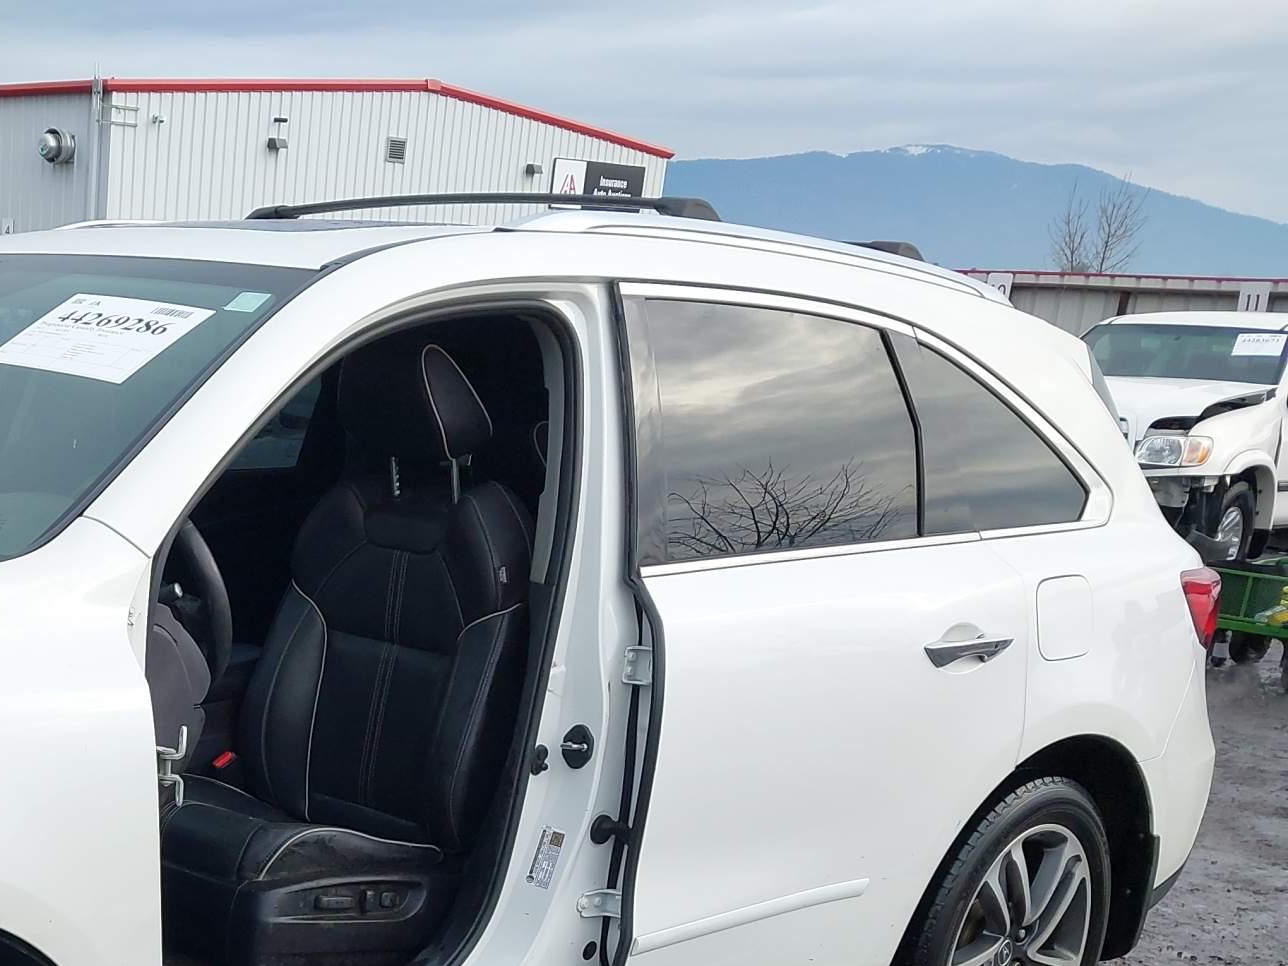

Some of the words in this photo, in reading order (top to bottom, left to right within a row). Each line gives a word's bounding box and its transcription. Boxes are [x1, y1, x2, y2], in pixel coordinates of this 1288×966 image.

[599, 175, 628, 189] Insurance
[593, 188, 607, 197] Auto
[1245, 294, 1260, 311] 11
[58, 310, 176, 336] 44269286
